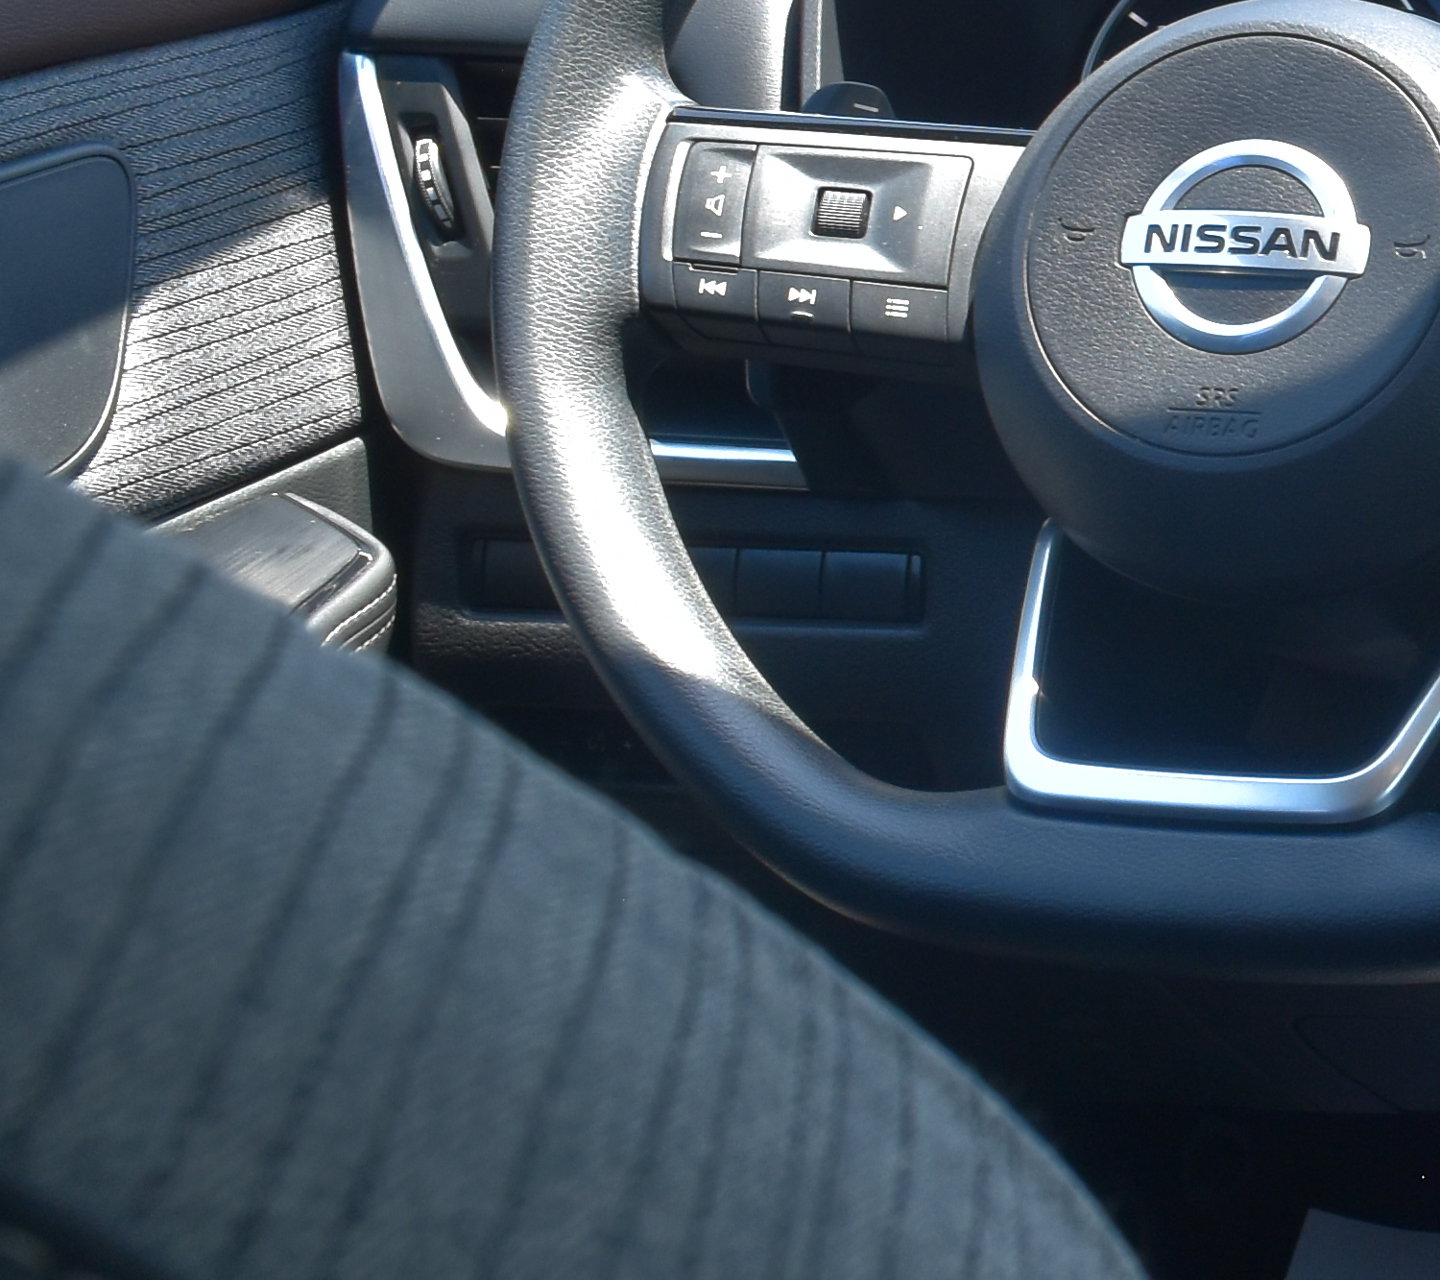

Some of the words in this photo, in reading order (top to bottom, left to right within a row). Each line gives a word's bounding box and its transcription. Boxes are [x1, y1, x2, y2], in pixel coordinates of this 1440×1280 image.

[1144, 223, 1340, 261] NISSAN
[1196, 387, 1238, 406] SRS
[1167, 415, 1259, 439] AIRBAG
